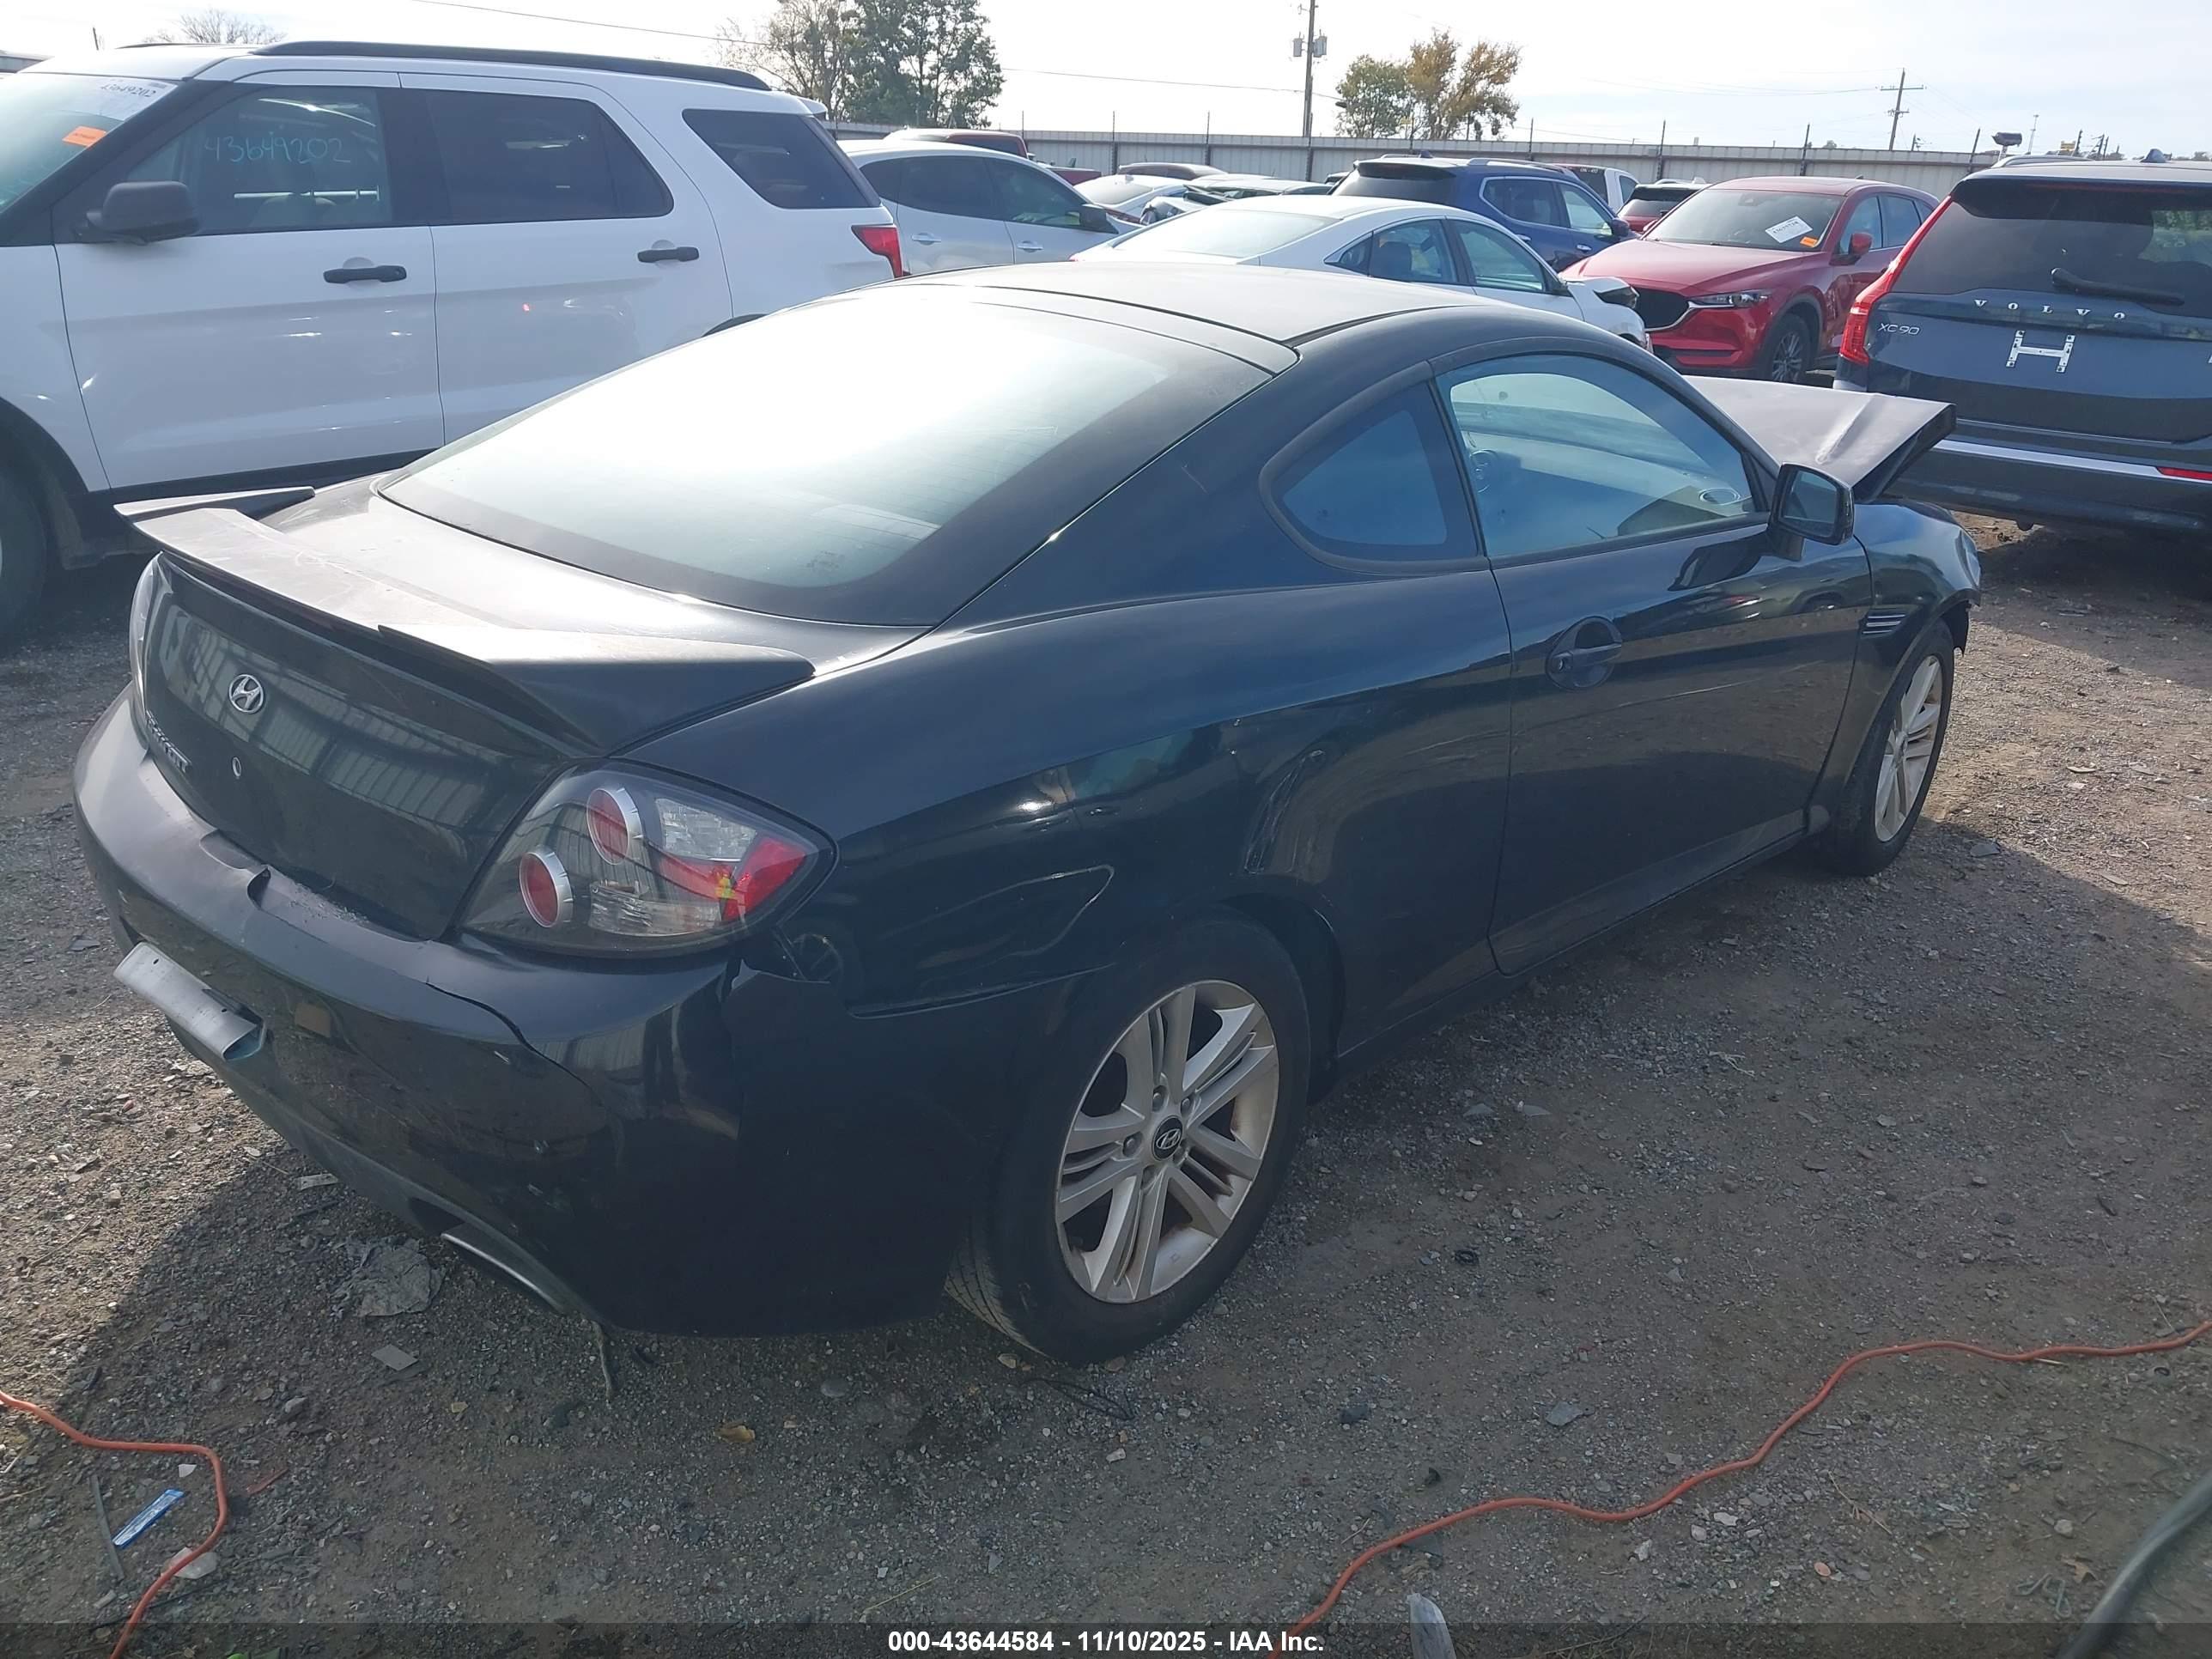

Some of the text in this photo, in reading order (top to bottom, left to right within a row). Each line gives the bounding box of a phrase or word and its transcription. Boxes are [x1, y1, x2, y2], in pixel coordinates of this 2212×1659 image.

[204, 134, 351, 163] 43649202
[1975, 299, 2124, 319] VOLVO
[1877, 323, 1920, 335] XC90
